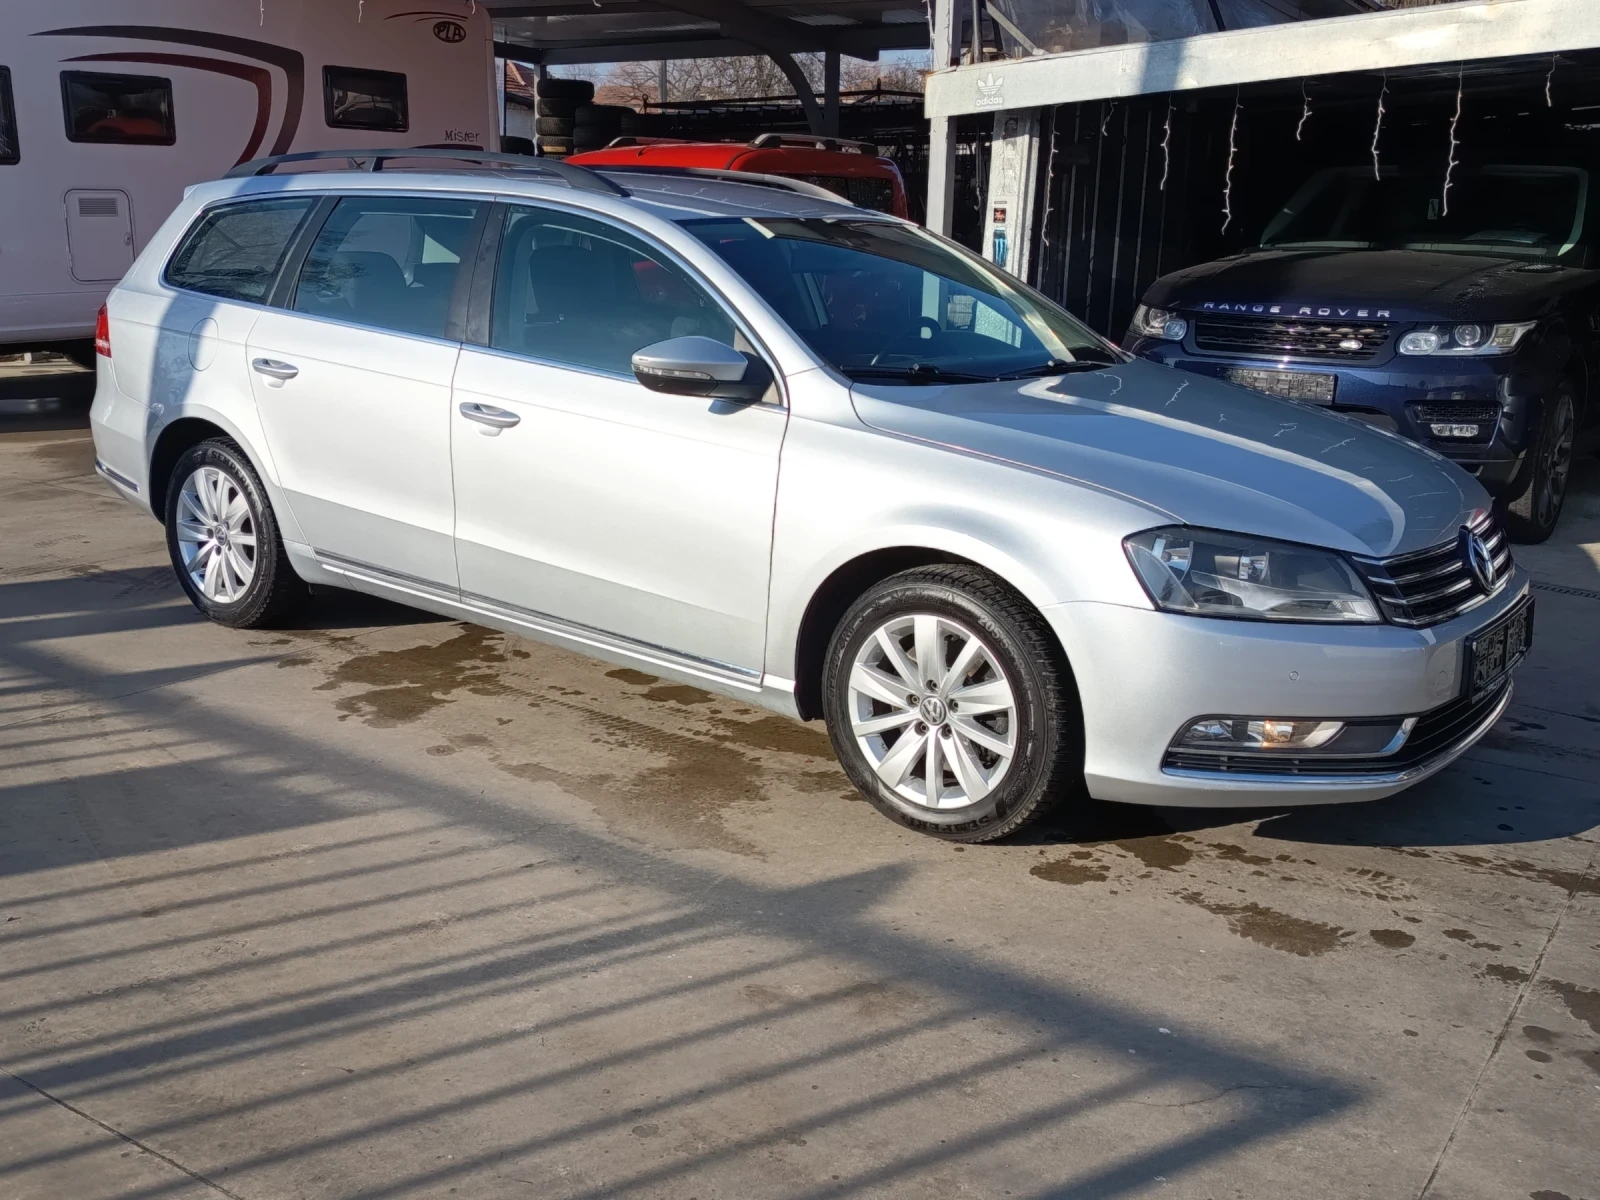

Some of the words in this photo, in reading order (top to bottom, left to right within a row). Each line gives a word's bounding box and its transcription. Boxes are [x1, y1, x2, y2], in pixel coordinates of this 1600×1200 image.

[435, 22, 464, 41] PLA
[975, 95, 1003, 106] adidas
[444, 128, 480, 143] Mister
[1204, 302, 1282, 314] RANGE
[1299, 306, 1390, 318] ROVER
